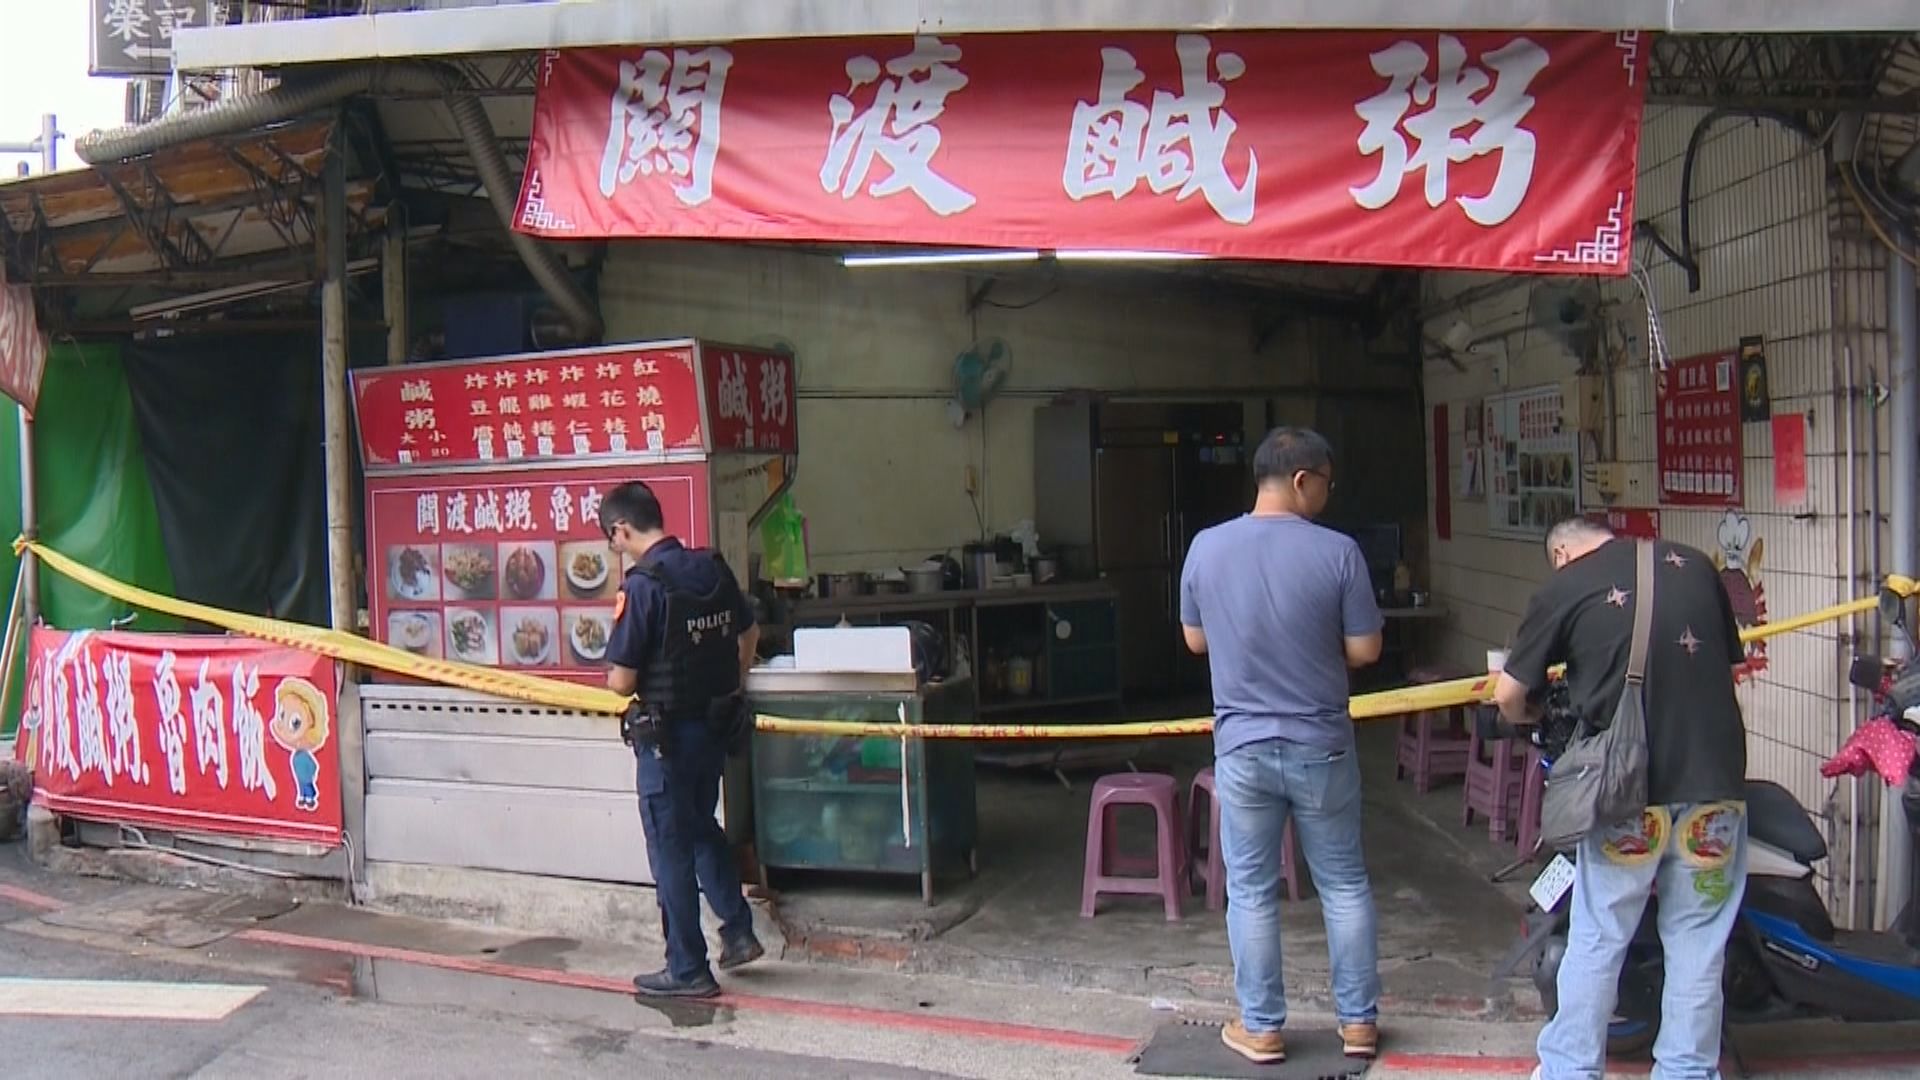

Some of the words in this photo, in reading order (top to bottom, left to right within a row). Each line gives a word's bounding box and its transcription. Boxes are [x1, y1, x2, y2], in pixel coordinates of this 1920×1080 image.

[103, 0, 196, 42] 榮記
[599, 34, 1550, 226] 關渡鹹粥
[400, 379, 436, 430] 鹹粥
[718, 352, 788, 427] 鹹粥
[687, 610, 731, 633] POLICE
